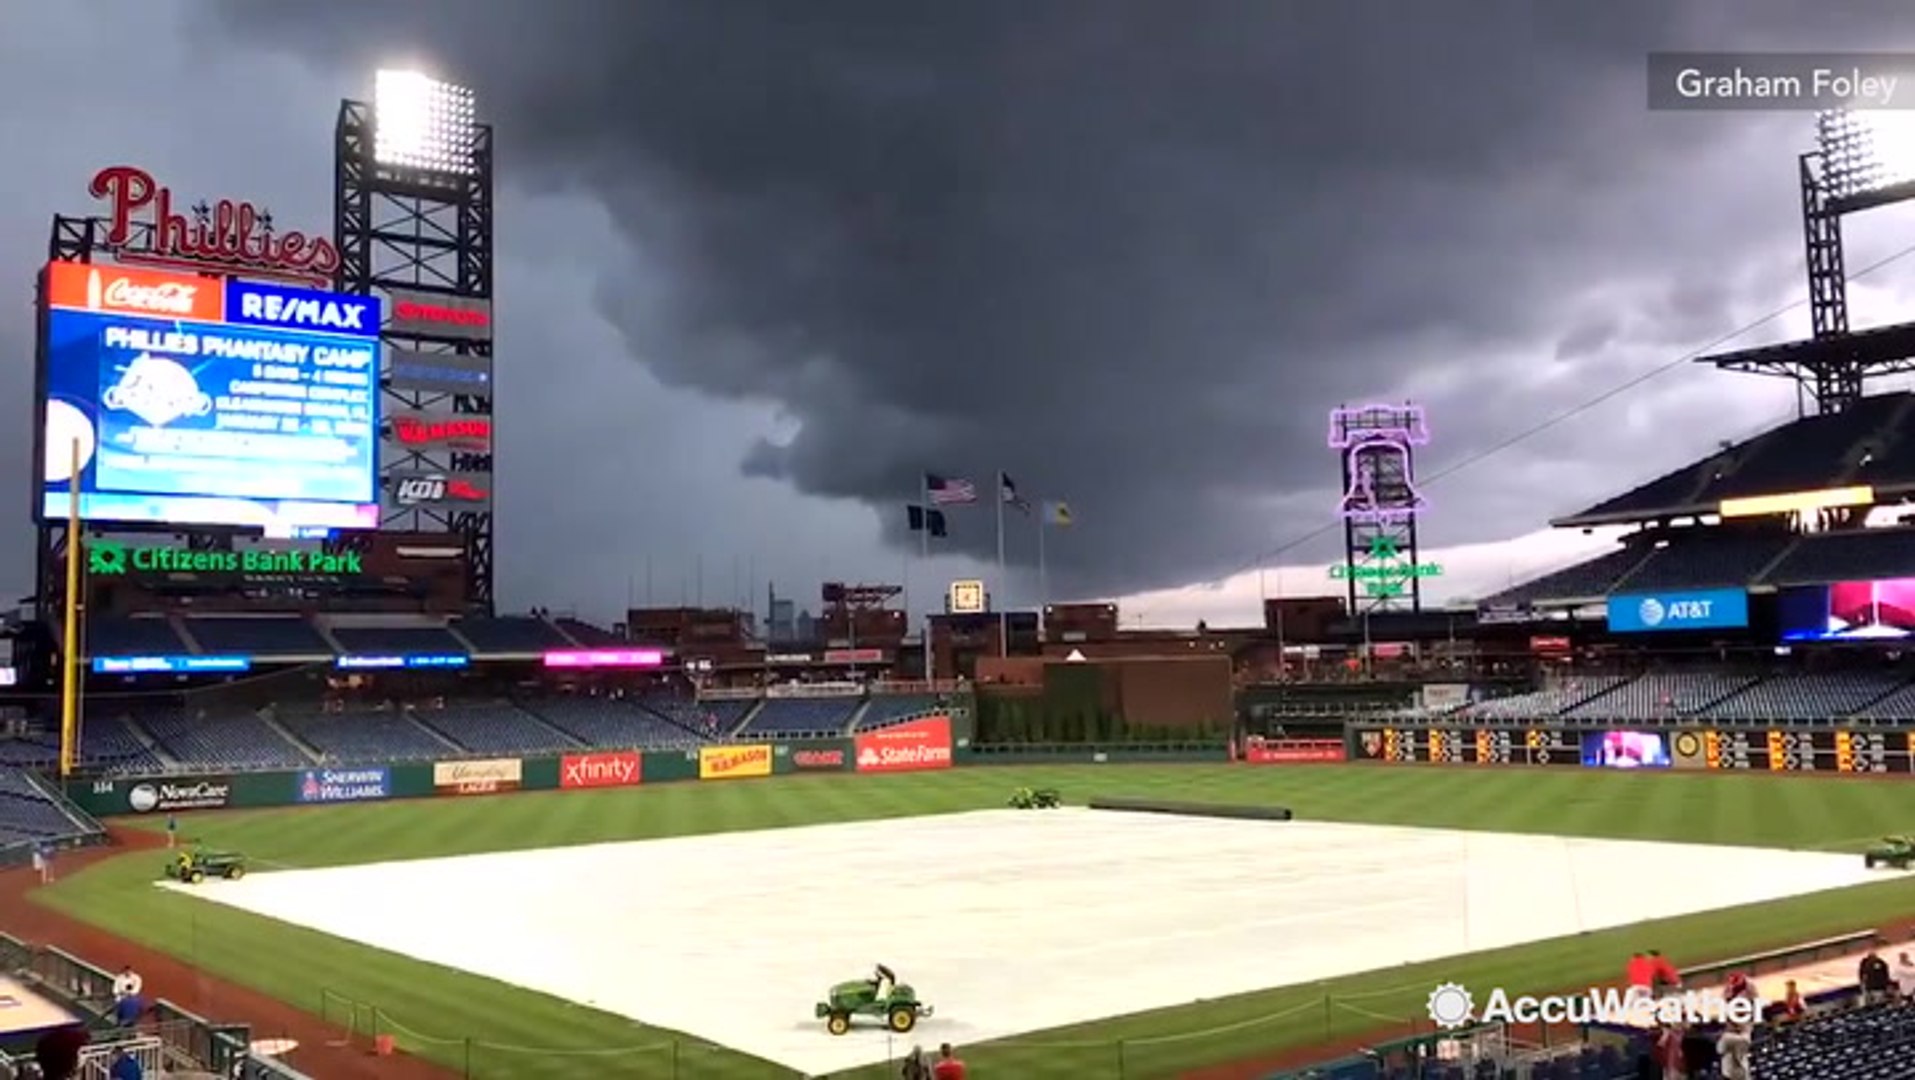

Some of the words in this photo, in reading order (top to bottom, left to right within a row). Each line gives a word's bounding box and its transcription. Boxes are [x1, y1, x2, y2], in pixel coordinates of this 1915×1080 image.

[89, 165, 341, 272] Phillies
[241, 292, 366, 329] RE/MAX
[105, 327, 199, 354] PHILLIES
[313, 346, 372, 368] CAMP
[132, 547, 238, 571] Citizens
[242, 550, 305, 572] Bank
[309, 551, 362, 574] Park
[1667, 600, 1713, 619] AT&T
[566, 757, 634, 785] xfinity
